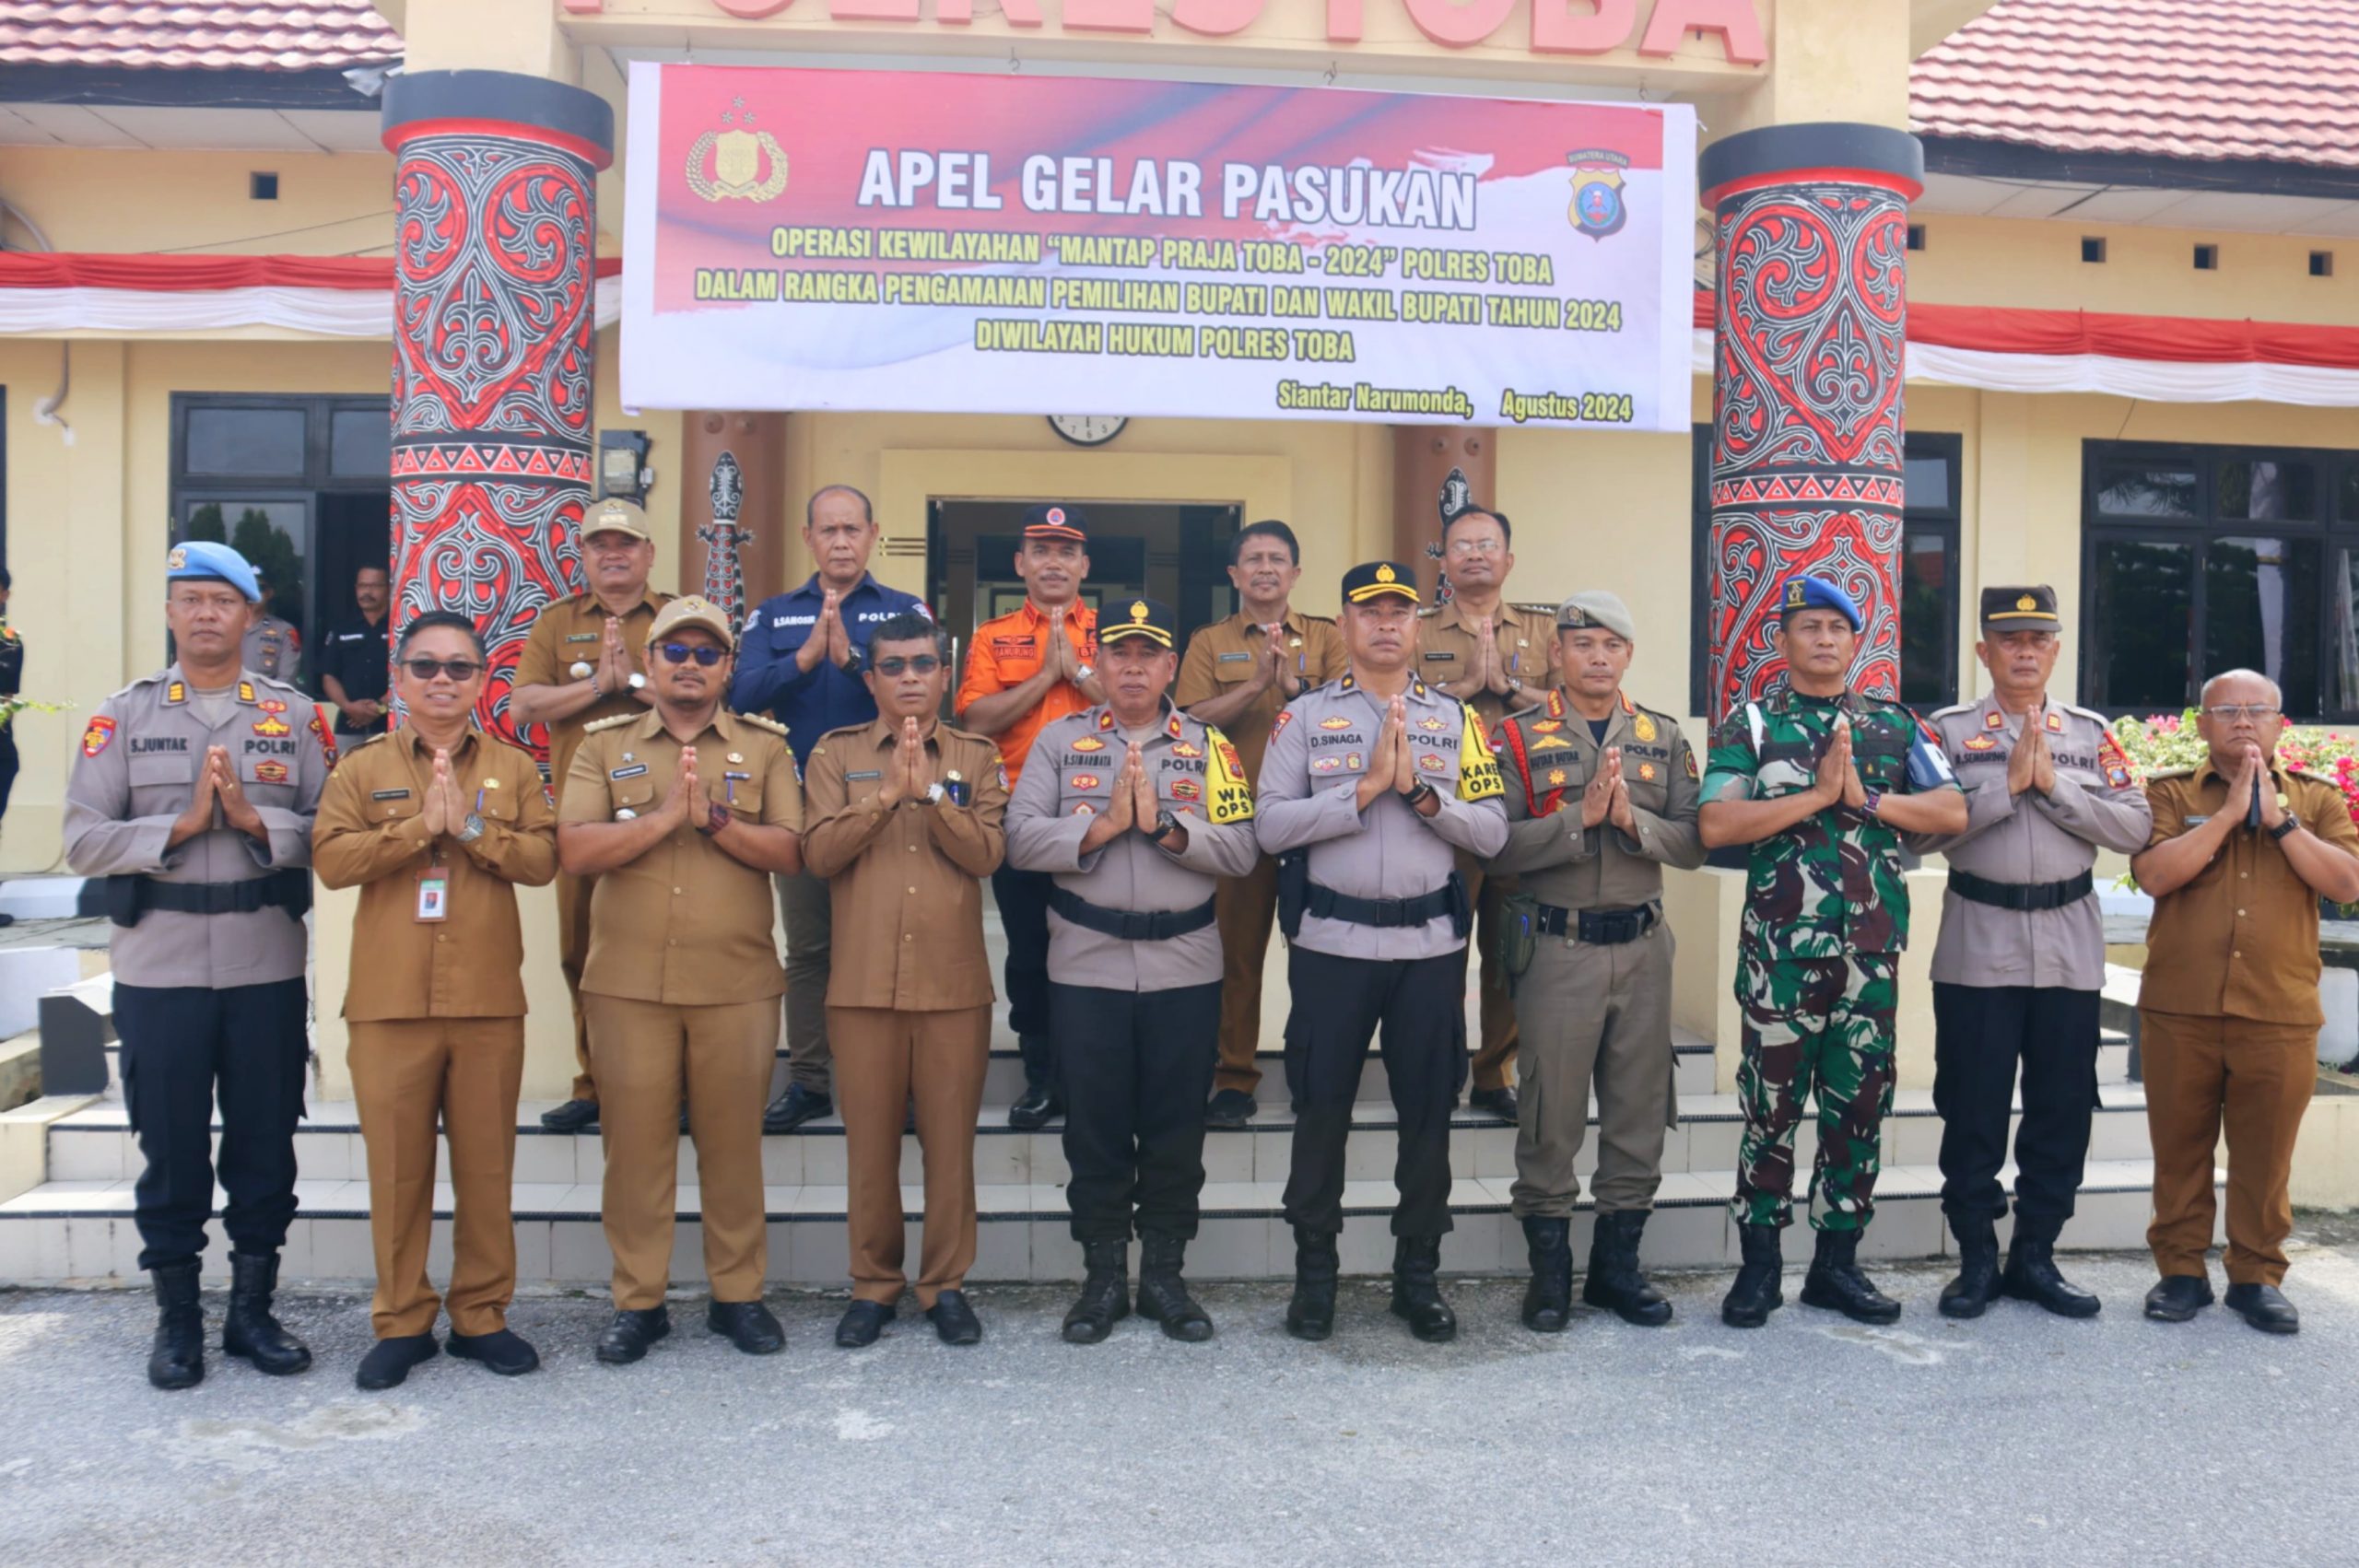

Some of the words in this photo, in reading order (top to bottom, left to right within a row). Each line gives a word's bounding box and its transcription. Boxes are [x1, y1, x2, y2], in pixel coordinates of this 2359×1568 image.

[856, 148, 1003, 210] APEL
[1021, 154, 1203, 217] GELAR
[1222, 162, 1476, 230] PASUKAN
[771, 226, 872, 259] OPERASI
[878, 228, 1040, 263] KEWILAYAHAN
[1161, 239, 1238, 272] PRAJA
[1242, 241, 1304, 275] TOBA
[1402, 248, 1489, 282] POLRES
[1495, 252, 1555, 286] TOBA
[695, 268, 778, 302] DALAM
[784, 270, 879, 304] RANGKA
[884, 273, 1046, 308] PENGAMANAN
[1051, 278, 1180, 313] PEMILIHAN
[1185, 282, 1267, 315] BUPATI
[1272, 285, 1320, 318] DAN
[1326, 287, 1397, 322] WAKIL
[1402, 291, 1482, 324] BUPATI
[1486, 295, 1560, 328] TAHUN
[1566, 299, 1622, 332] 2024
[975, 318, 1101, 354] DIWILAYAH
[1108, 323, 1194, 357] HUKUM
[1199, 326, 1289, 360] POLRES
[1293, 330, 1356, 362] TOBA
[1277, 380, 1351, 409] Siantar
[1355, 383, 1473, 418] Narumonda,
[1500, 388, 1579, 423] Agustus
[1582, 392, 1633, 423] 2024
[131, 738, 187, 753] S.JUNTAK
[244, 739, 296, 755] POLRI
[1310, 734, 1363, 748] D.SINAGA
[1407, 734, 1458, 750] POLRI
[1624, 743, 1649, 756] POL
[1651, 747, 1668, 759] PP
[1470, 778, 1500, 793] OPS
[1216, 801, 1250, 817] OPS
